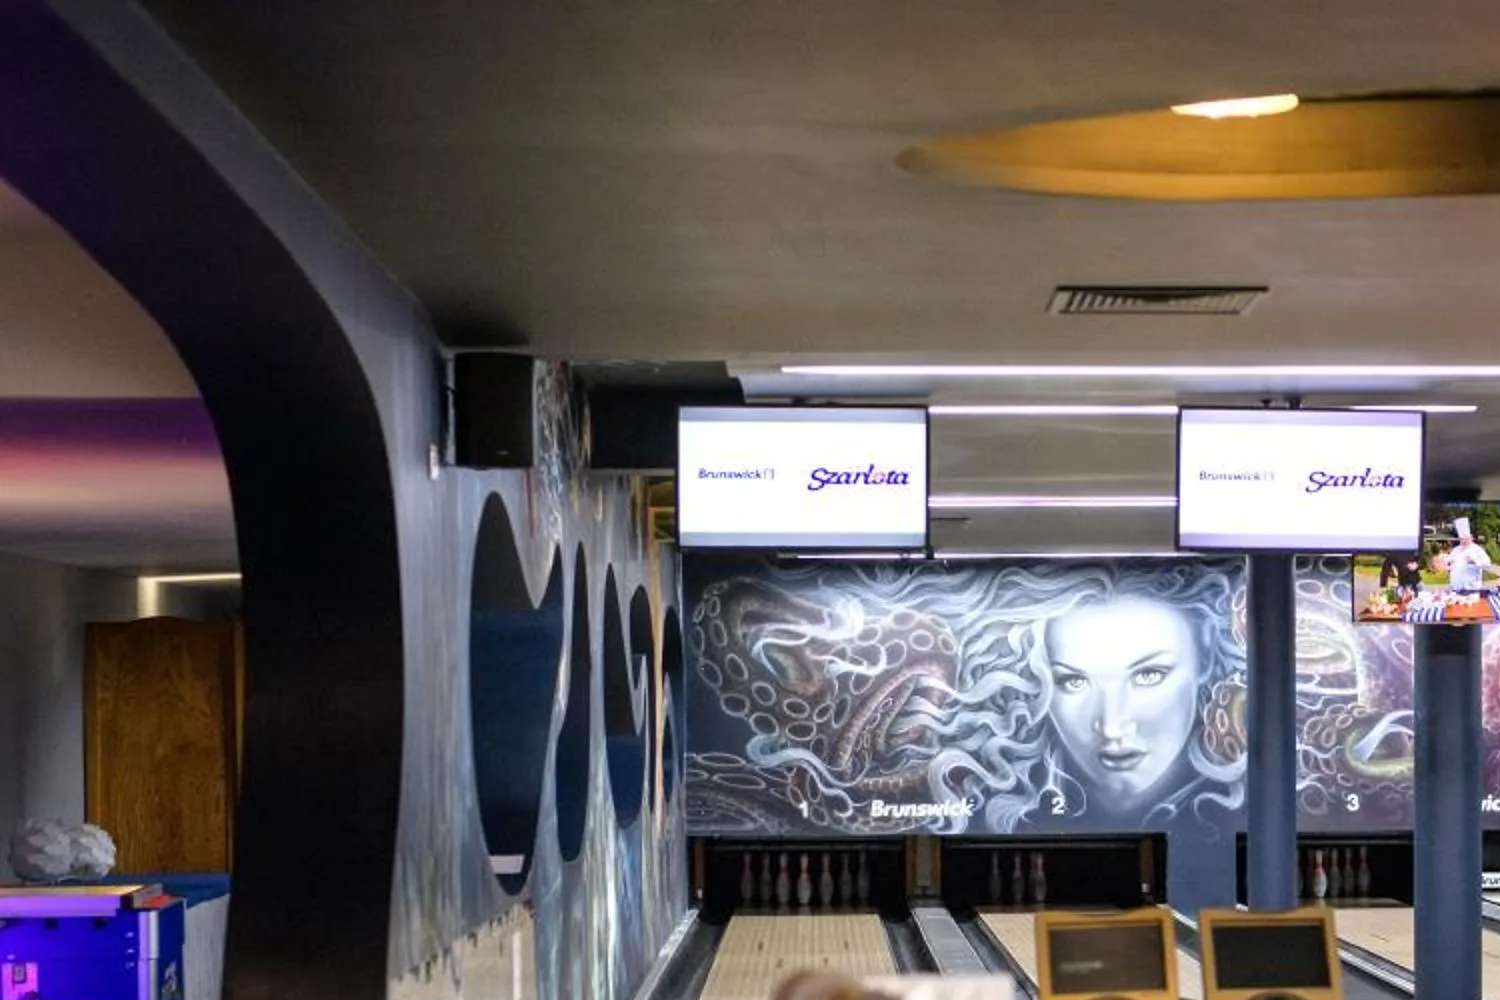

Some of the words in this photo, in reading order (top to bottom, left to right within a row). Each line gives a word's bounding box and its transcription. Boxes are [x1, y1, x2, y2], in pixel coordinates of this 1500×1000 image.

[697, 467, 762, 480] Brunswick
[807, 463, 909, 491] Szarlota
[1305, 467, 1404, 493] Szarlota
[799, 801, 809, 818] 1
[869, 798, 974, 818] Brunswick
[1051, 797, 1065, 815] 2
[1346, 793, 1361, 812] 3
